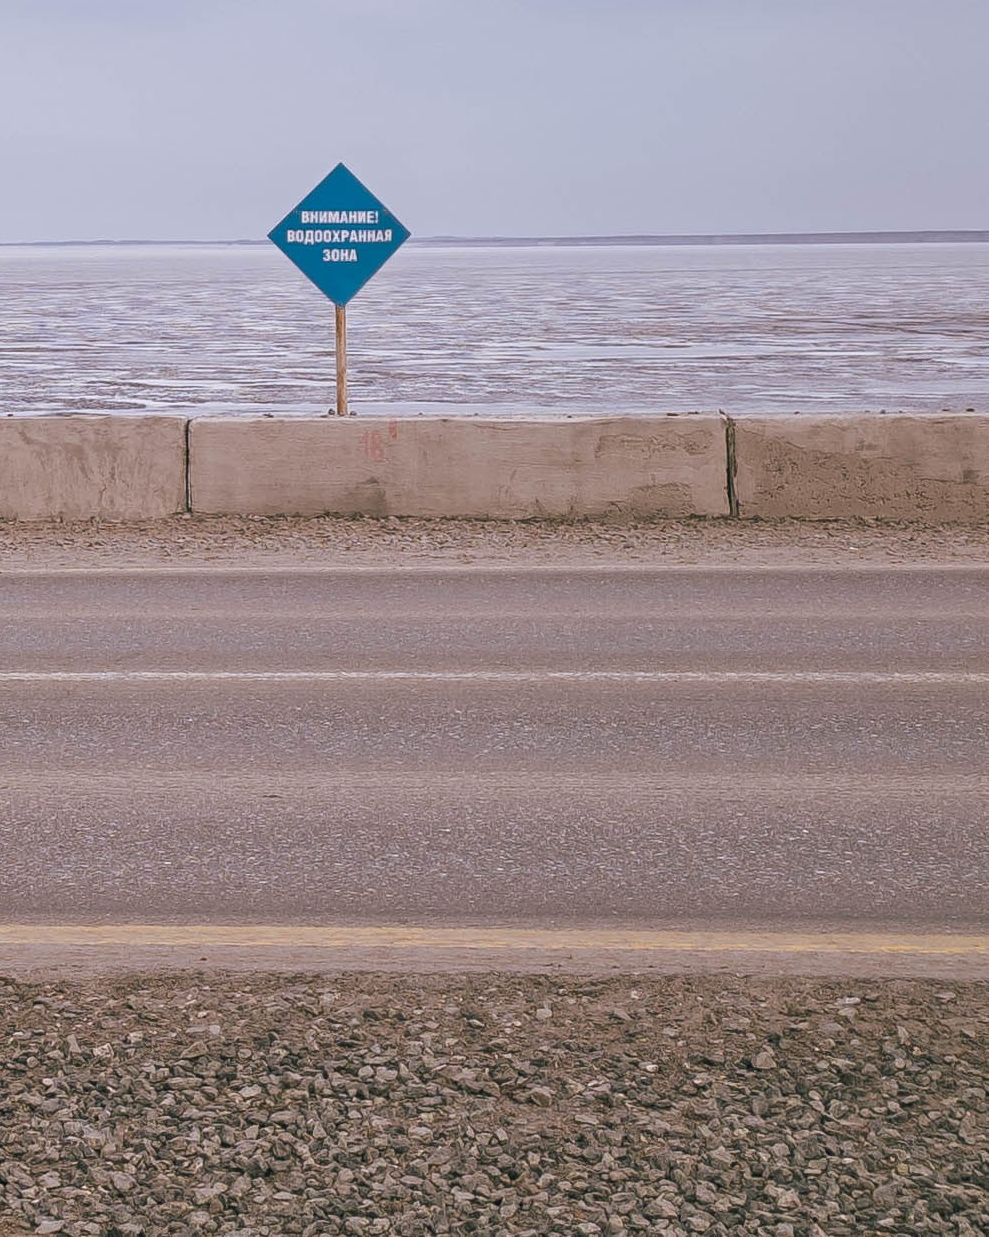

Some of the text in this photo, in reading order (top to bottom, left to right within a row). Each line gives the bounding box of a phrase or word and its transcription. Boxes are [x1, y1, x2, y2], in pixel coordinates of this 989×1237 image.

[301, 210, 379, 224] ВНИМАНИЕ!
[286, 229, 393, 245] ВОДООХРАННАЯ
[322, 248, 358, 262] ЗОНА
